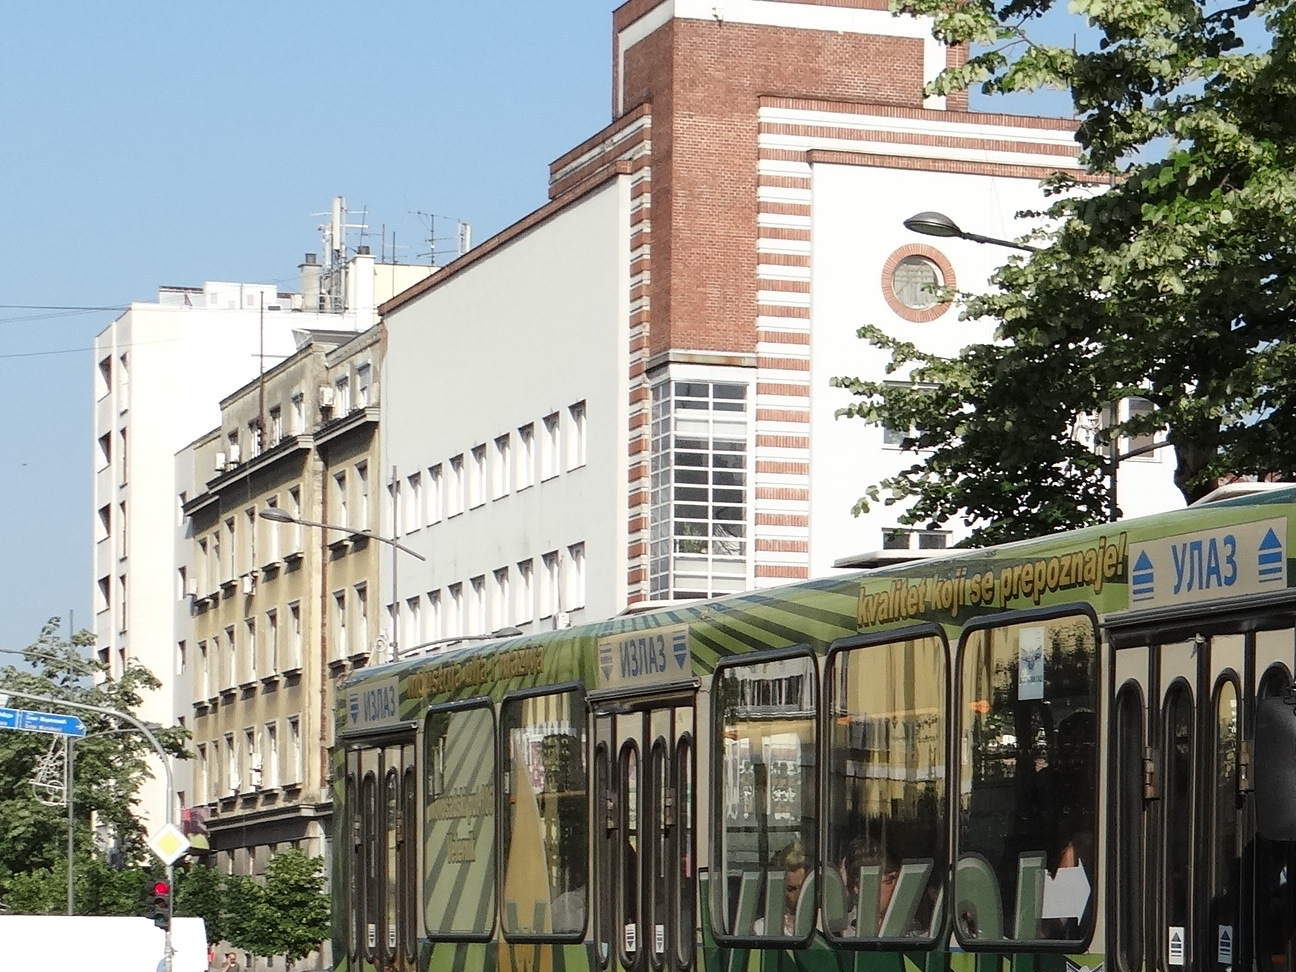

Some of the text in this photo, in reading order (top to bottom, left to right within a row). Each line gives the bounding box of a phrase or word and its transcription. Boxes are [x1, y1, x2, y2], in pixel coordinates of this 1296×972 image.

[930, 568, 967, 619] koji
[969, 567, 995, 603] se
[998, 532, 1128, 609] prepoznaje!
[1171, 534, 1238, 595] УЛАЗ
[620, 634, 667, 678] ИЗЛАЗ
[363, 685, 396, 722] ИЗЛАЗ
